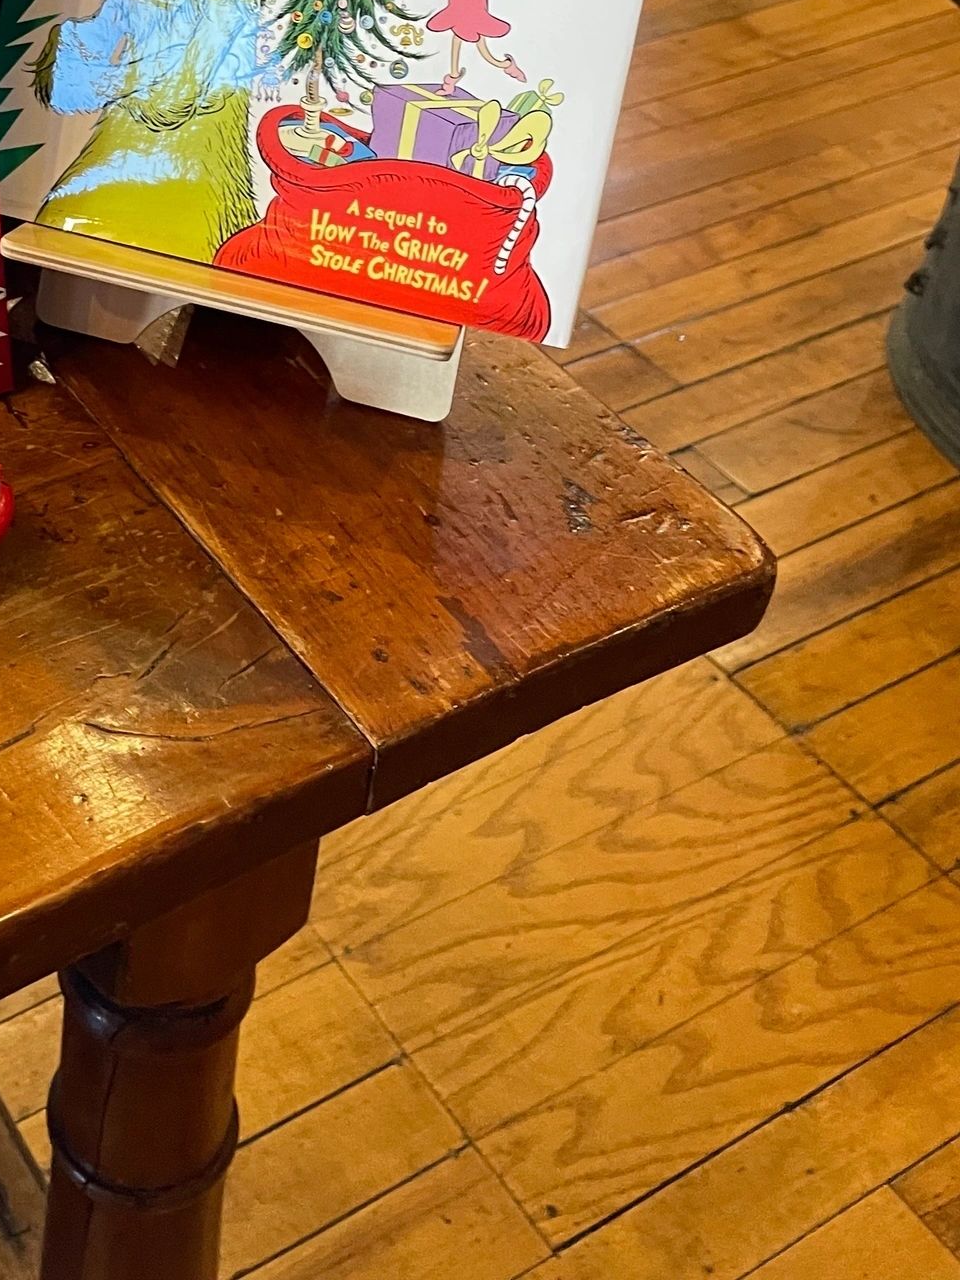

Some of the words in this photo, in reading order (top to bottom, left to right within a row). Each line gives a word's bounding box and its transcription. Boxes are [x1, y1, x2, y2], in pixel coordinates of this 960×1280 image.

[346, 198, 361, 217] A
[365, 205, 422, 231] sequel
[427, 216, 448, 236] to
[310, 244, 365, 274] STOLE
[359, 231, 390, 253] The
[393, 232, 469, 271] GRINCH
